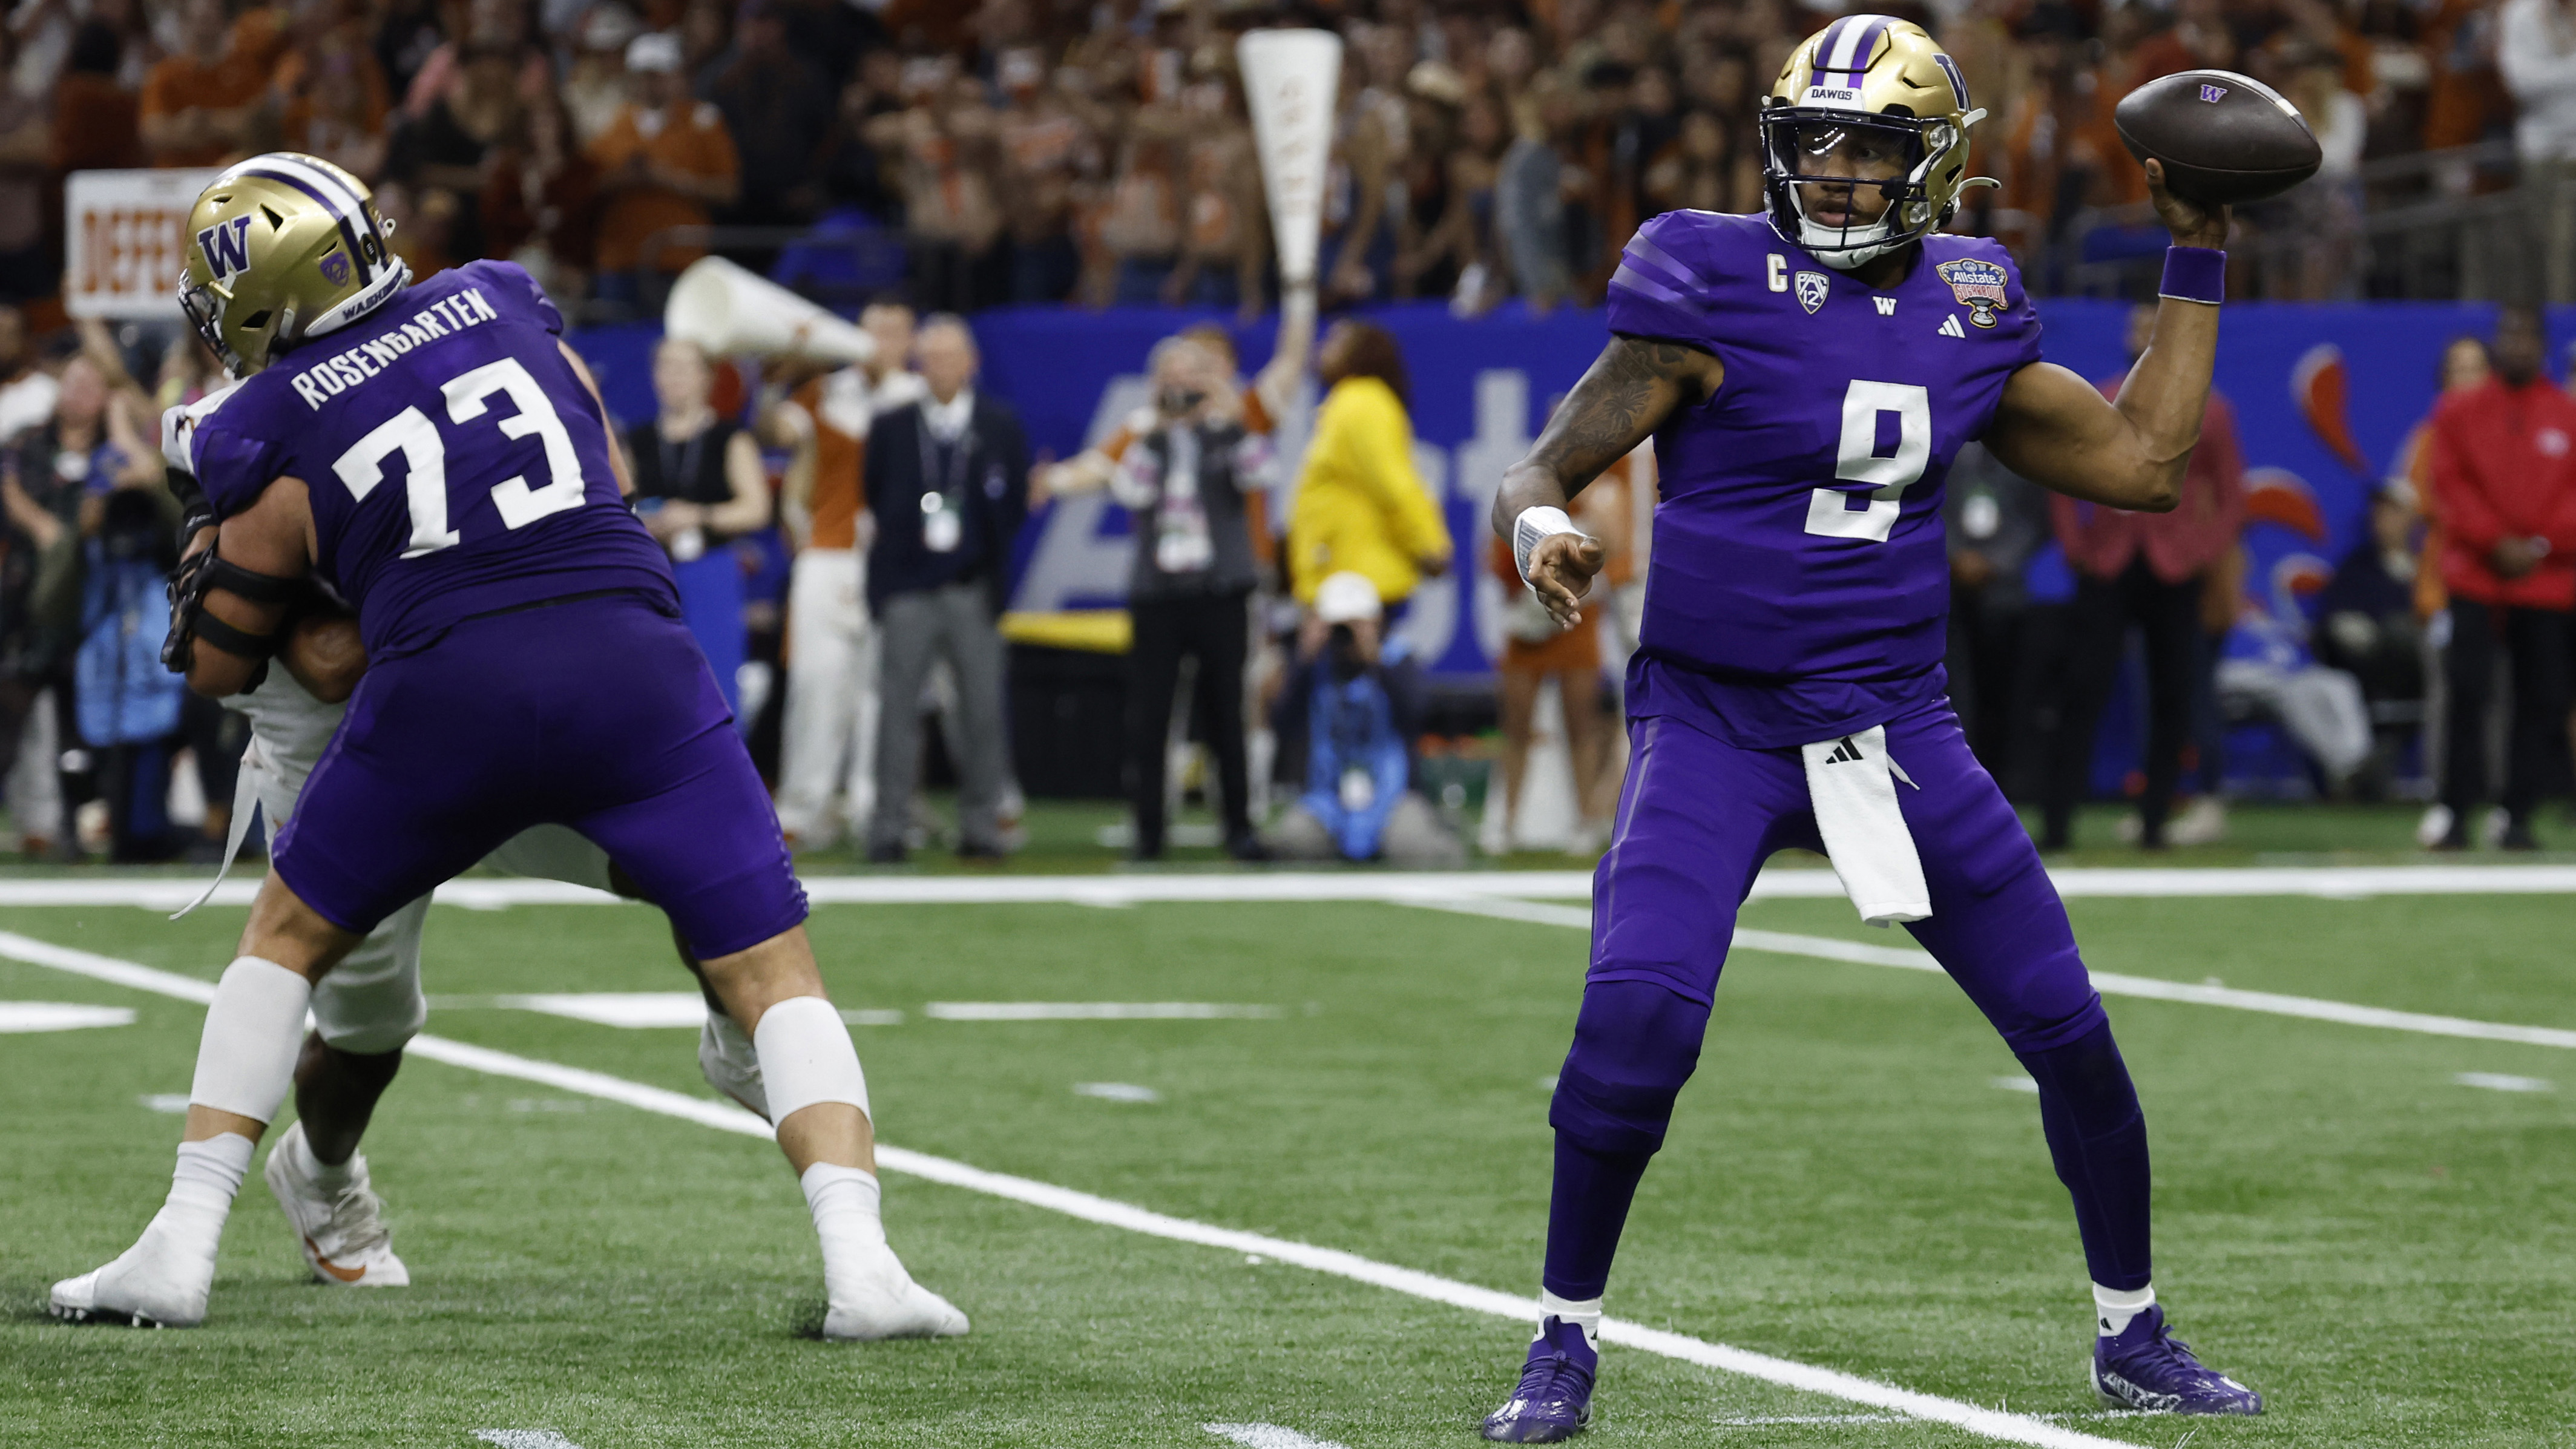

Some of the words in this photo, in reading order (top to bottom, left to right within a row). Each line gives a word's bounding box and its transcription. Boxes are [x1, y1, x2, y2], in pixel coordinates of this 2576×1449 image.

[1812, 89, 1852, 100] DAWGS
[2200, 84, 2228, 103] W
[197, 214, 252, 280] W
[1767, 253, 1788, 292] C
[1953, 271, 1997, 284] Allstate
[1798, 273, 1828, 299] PAC
[1804, 289, 1819, 306] 12
[1873, 296, 1897, 315] W
[291, 288, 497, 412] ROSENGARTEN
[332, 357, 585, 559] 73
[1804, 380, 1932, 542] 9
